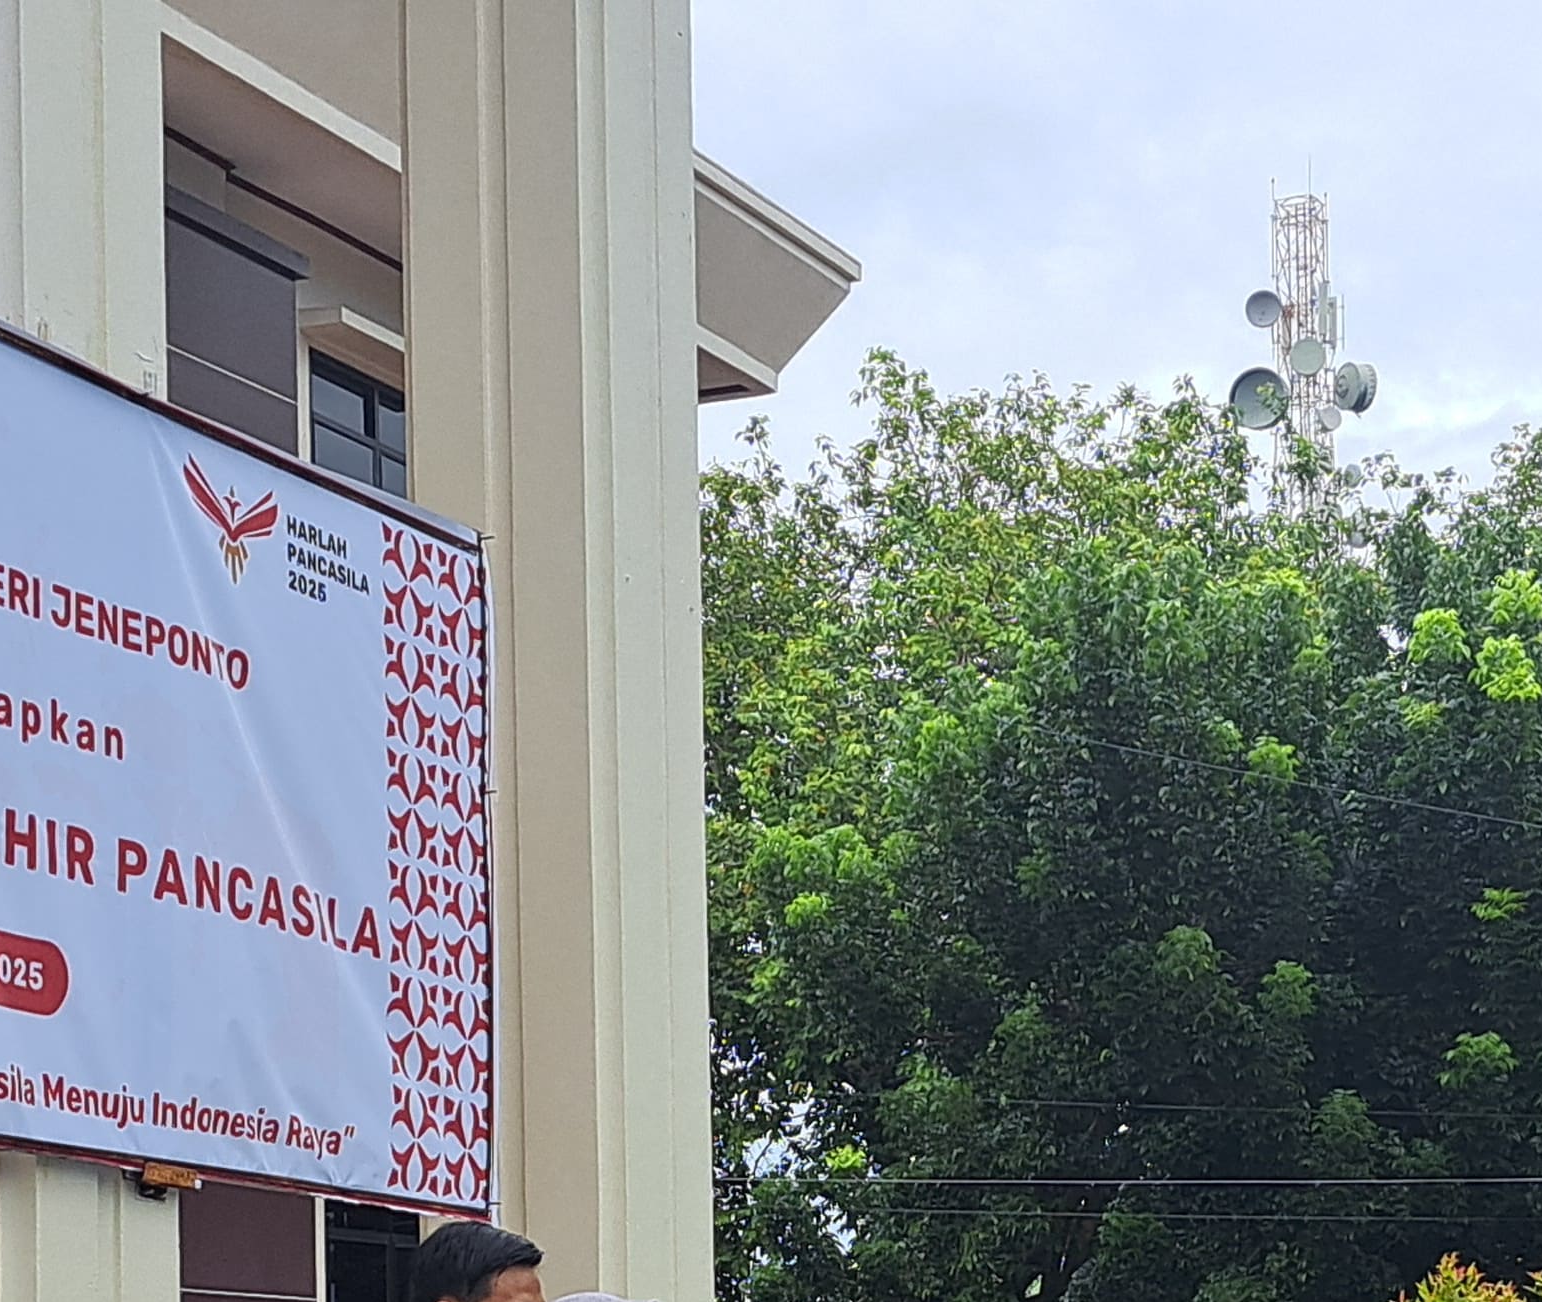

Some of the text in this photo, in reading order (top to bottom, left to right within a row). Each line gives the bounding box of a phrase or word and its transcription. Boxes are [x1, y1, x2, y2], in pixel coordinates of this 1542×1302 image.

[287, 515, 348, 559] HARLAH
[287, 544, 370, 596] PANCASILA
[50, 583, 250, 690] JENEPONTO
[117, 837, 381, 959] PANCASILA
[43, 1073, 145, 1129] Menuju
[153, 1093, 280, 1144] Indonesia
